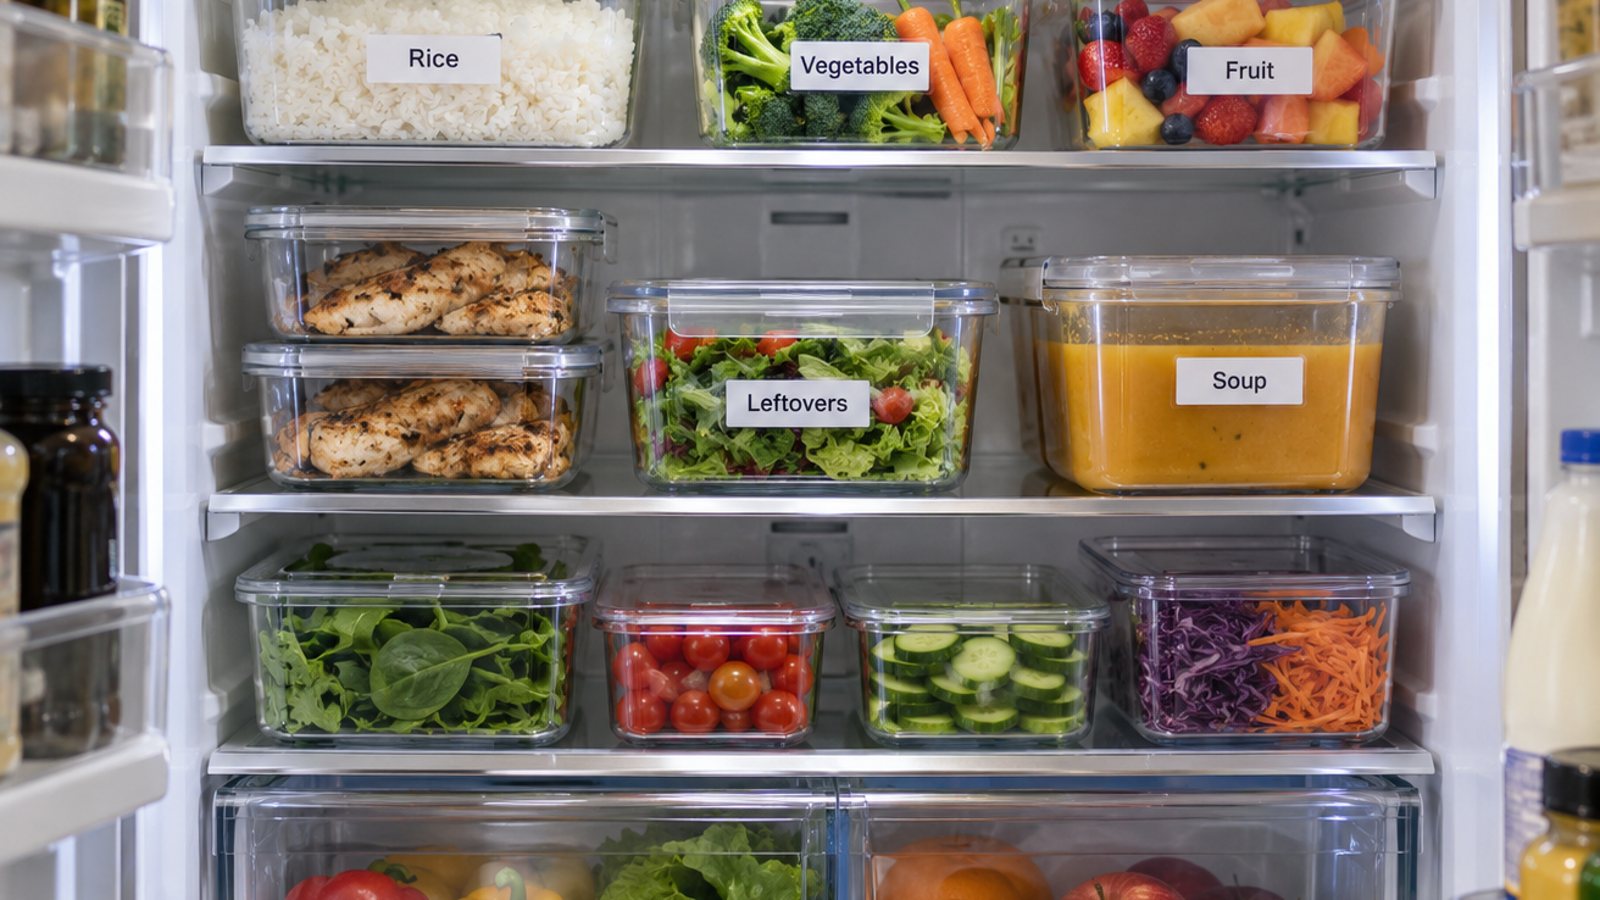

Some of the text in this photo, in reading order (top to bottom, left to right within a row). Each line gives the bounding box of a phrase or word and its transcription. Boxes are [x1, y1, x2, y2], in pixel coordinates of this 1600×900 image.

[409, 48, 459, 68] Rice
[800, 56, 920, 79] Vegetables
[1226, 61, 1275, 79] Fruit
[1212, 371, 1267, 393] Soup
[748, 394, 848, 412] Leftovers
